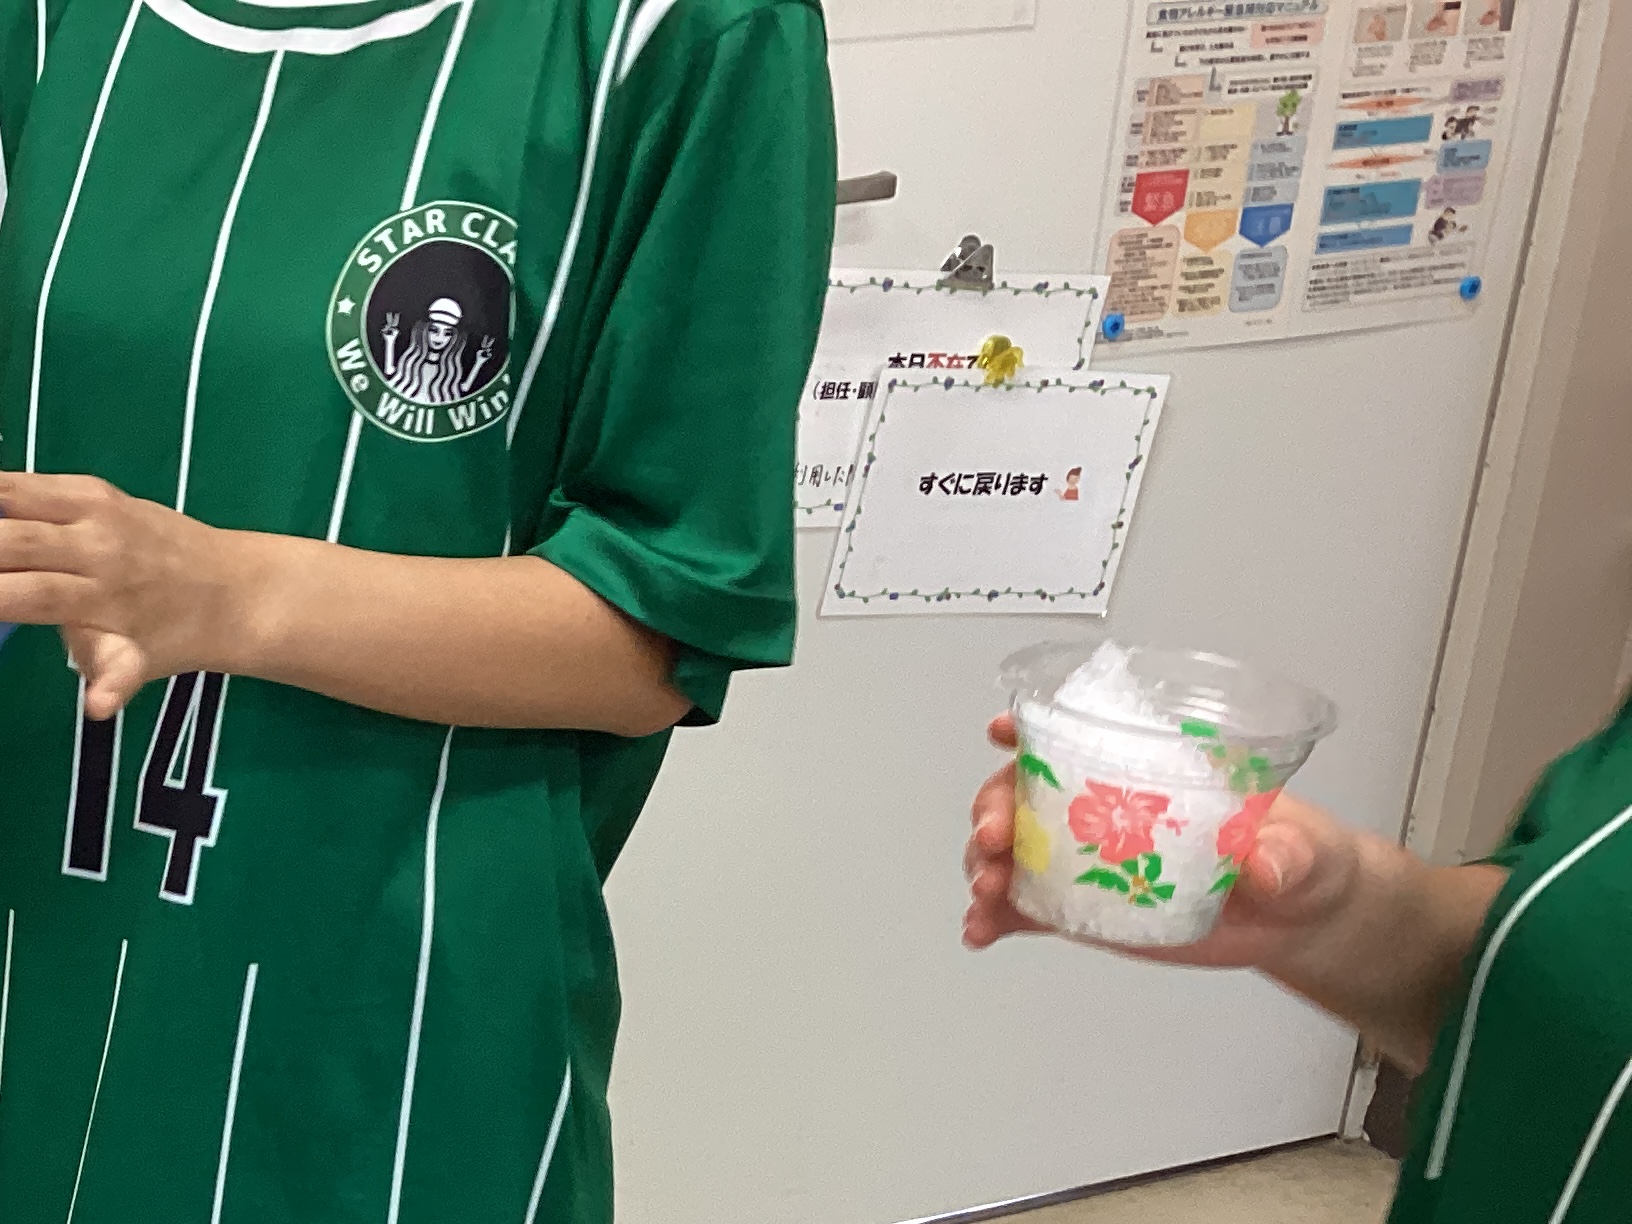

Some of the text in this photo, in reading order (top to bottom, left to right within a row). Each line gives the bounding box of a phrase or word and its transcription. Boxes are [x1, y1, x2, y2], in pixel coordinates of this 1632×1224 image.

[357, 208, 448, 274] STAR
[336, 338, 370, 393] We
[376, 391, 435, 434] Will
[919, 472, 1049, 496] すぐに戻ります
[61, 648, 230, 906] 14
